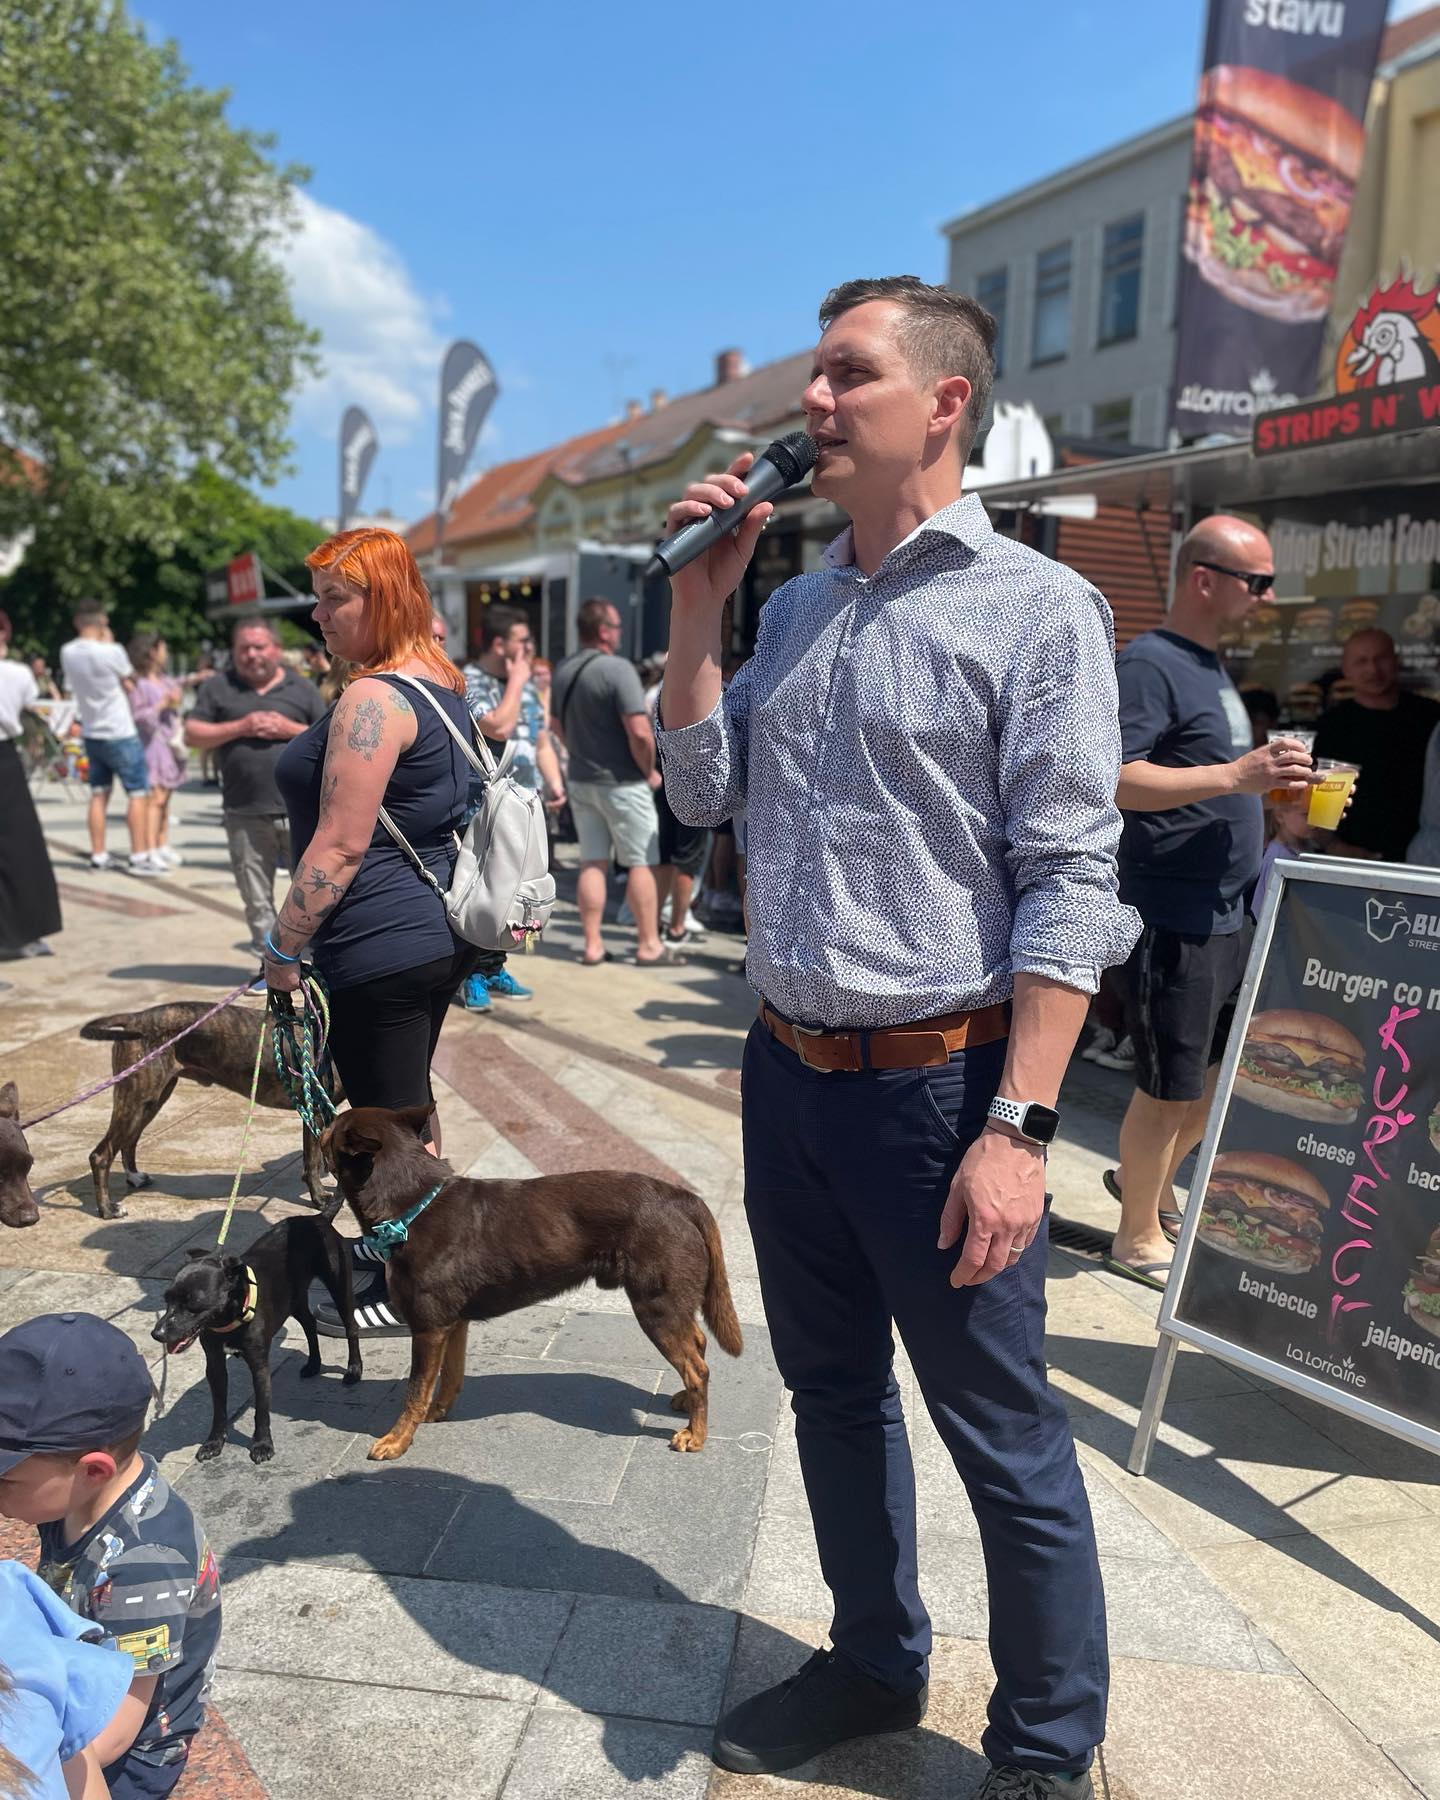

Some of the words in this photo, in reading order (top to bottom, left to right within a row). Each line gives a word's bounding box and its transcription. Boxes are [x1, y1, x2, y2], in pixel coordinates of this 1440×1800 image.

[1243, 0, 1345, 38] stavu
[1257, 401, 1361, 450] STRIPS
[1323, 518, 1394, 571] Street
[1395, 513, 1440, 564] Foo
[1408, 939, 1440, 951] STREE
[1302, 957, 1388, 1003] Burger
[1297, 1133, 1356, 1166] cheese
[1407, 1161, 1440, 1192] bac
[1238, 1271, 1318, 1319] barbecue
[1286, 1343, 1304, 1361] La
[1305, 1351, 1367, 1388] Lorraine
